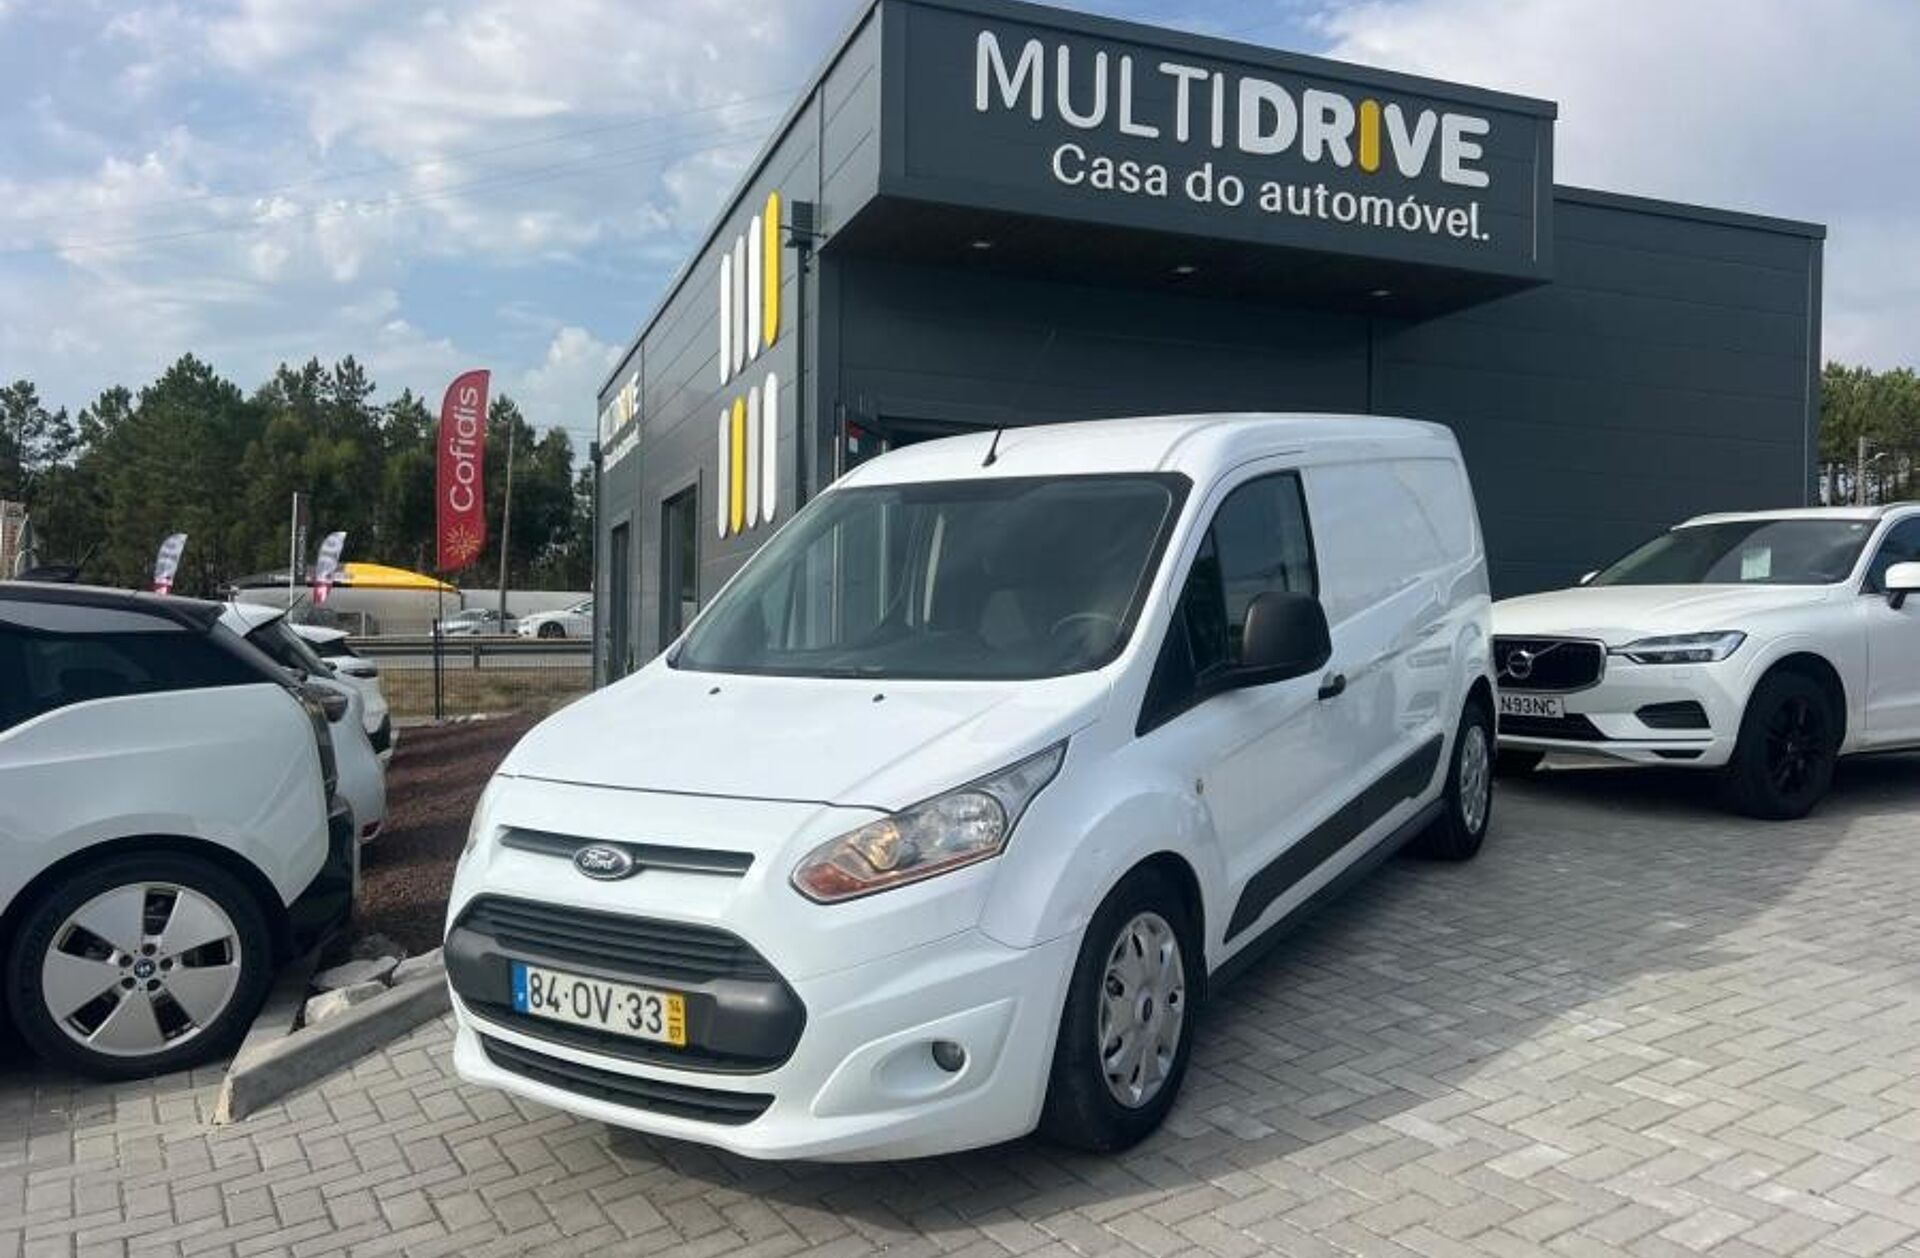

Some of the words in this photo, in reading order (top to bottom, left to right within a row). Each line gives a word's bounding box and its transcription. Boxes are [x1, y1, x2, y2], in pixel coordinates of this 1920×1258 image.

[976, 30, 1490, 188] MULTIDRIVE
[1052, 143, 1168, 197] Casa
[1185, 162, 1245, 207] do
[1259, 181, 1490, 241] automóvel.
[449, 386, 478, 512] Cofidis
